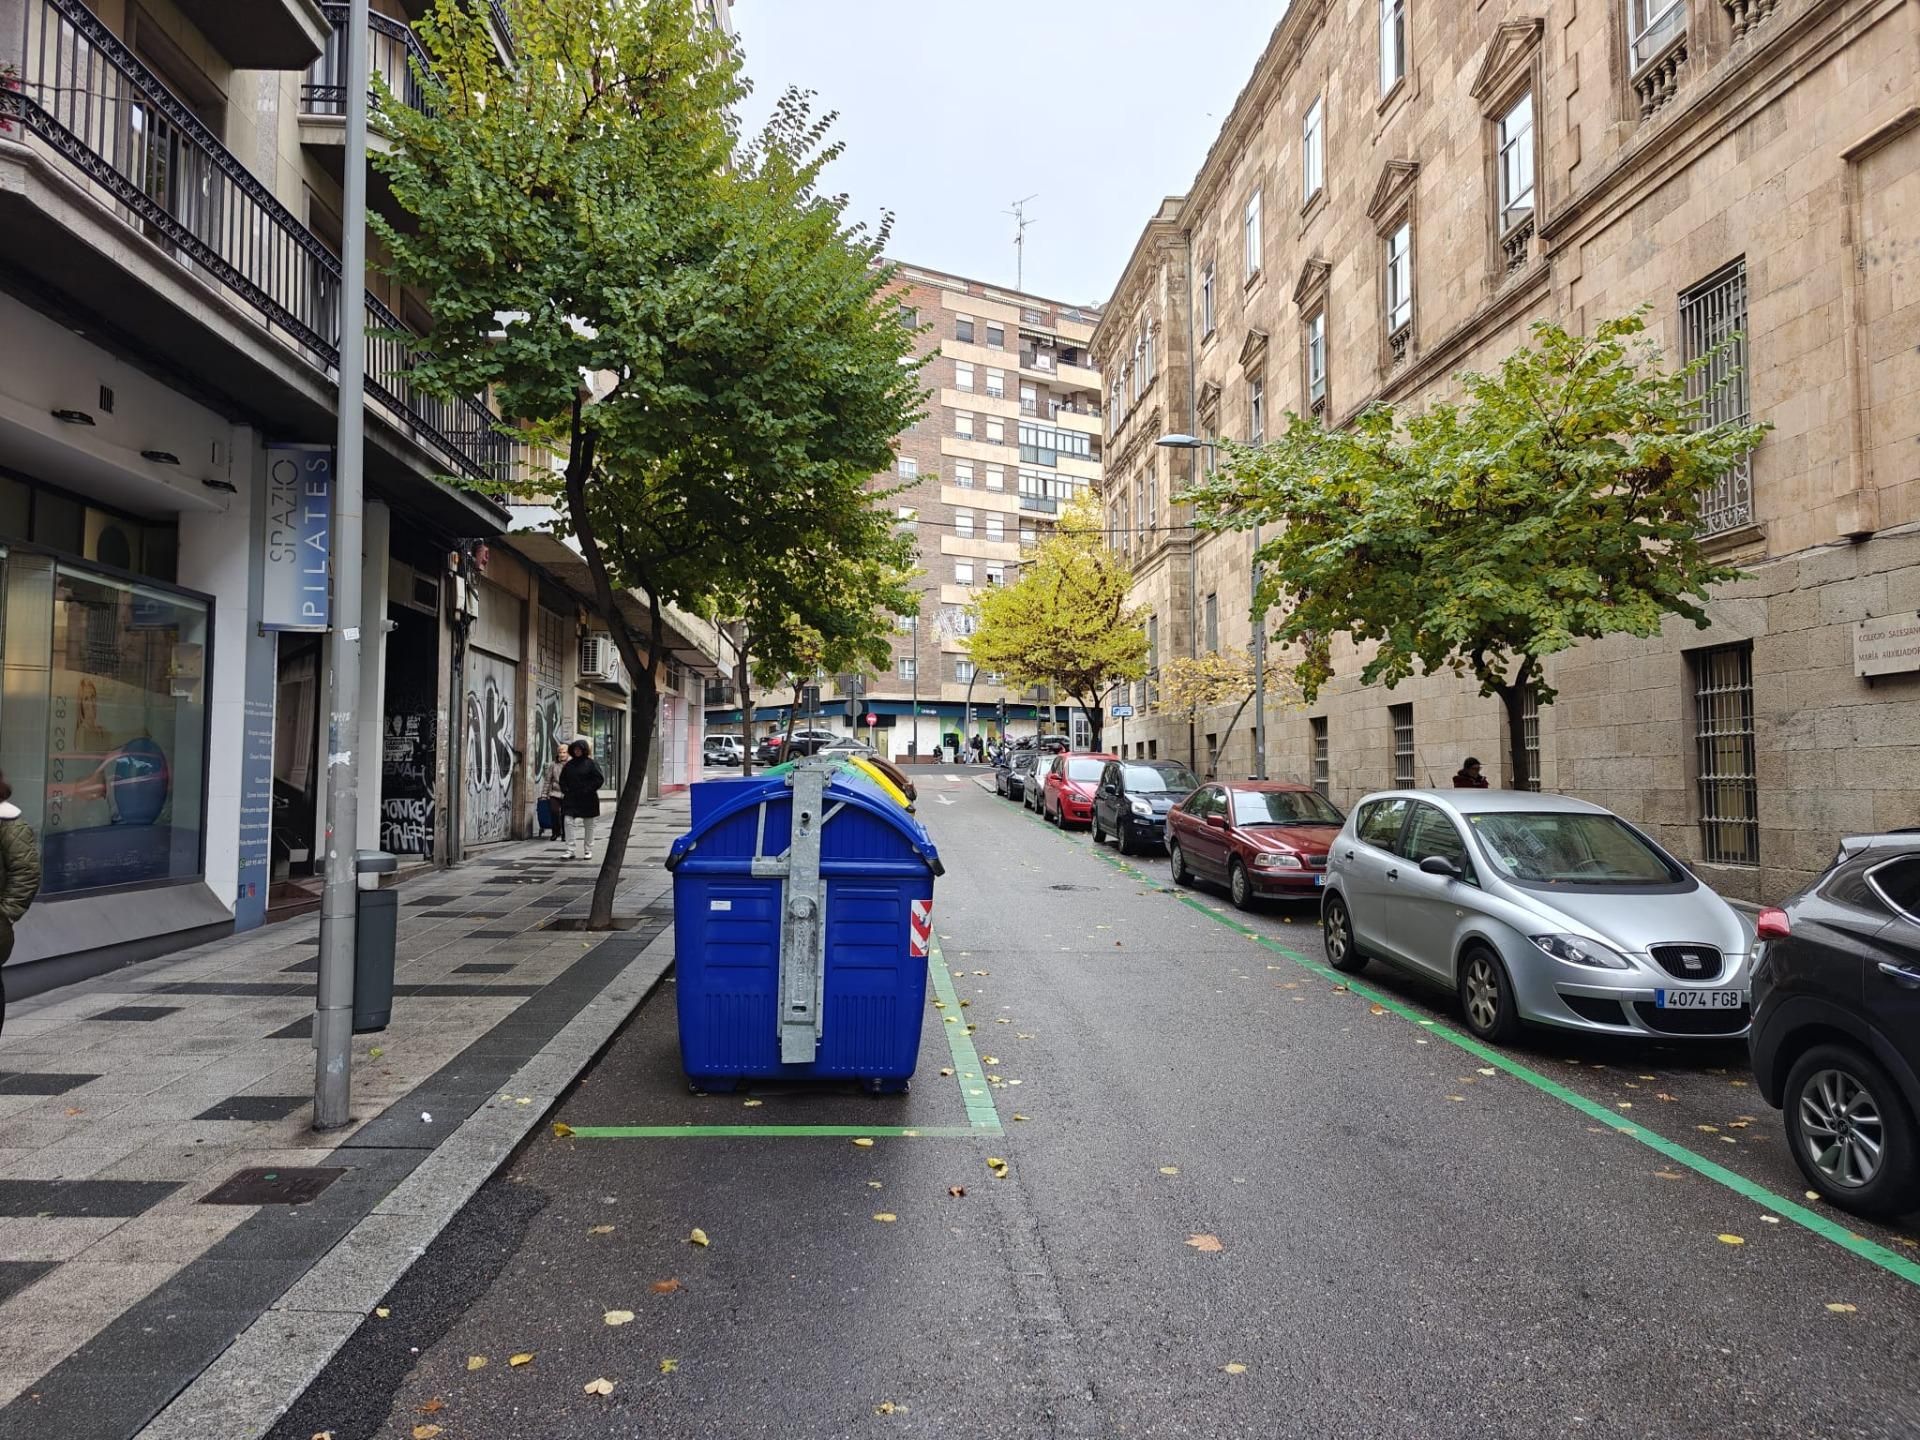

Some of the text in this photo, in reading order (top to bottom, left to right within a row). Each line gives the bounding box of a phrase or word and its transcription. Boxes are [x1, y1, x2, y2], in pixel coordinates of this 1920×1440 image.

[269, 459, 298, 563] SPAZIO
[302, 458, 328, 617] PILATES
[1859, 632, 1886, 642] COLEGIO
[1859, 651, 1879, 662] MARÍA
[55, 696, 67, 719] 82
[54, 727, 66, 752] 02
[52, 757, 65, 783] 62
[1668, 991, 1738, 1007] 4074 FGB
